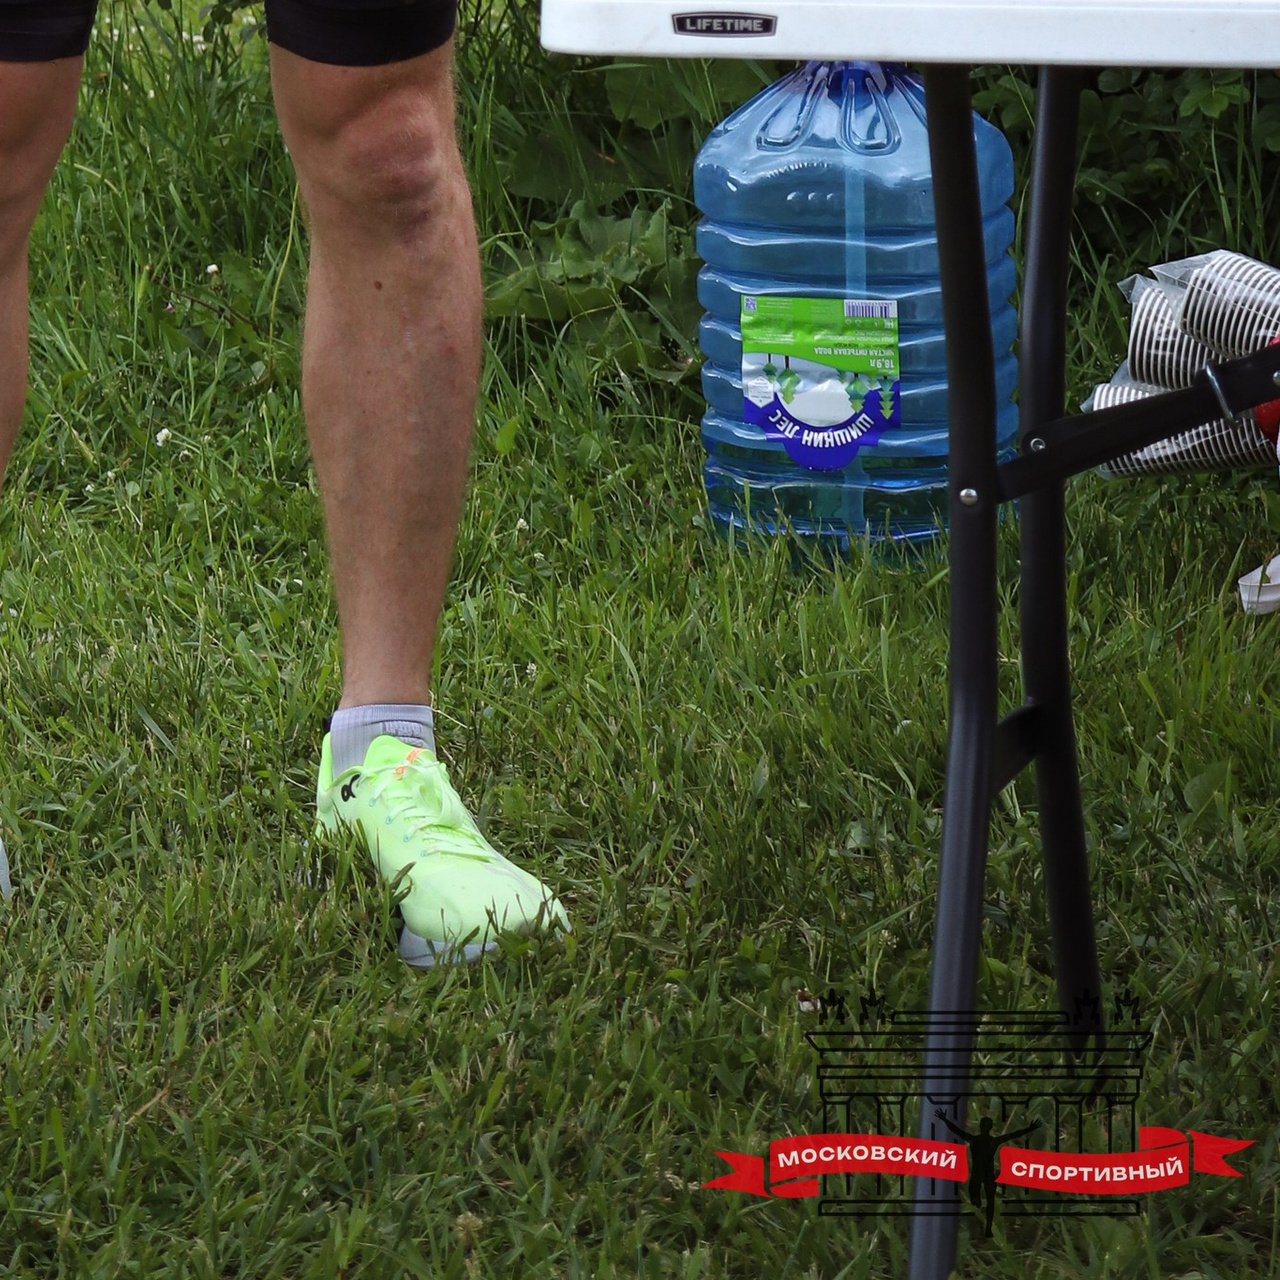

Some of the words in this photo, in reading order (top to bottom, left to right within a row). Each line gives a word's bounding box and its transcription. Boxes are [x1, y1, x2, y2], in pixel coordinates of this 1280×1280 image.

[686, 18, 763, 31] LIFETIME
[767, 409, 800, 439] ЛЕС
[801, 412, 875, 448] ШИШКИН
